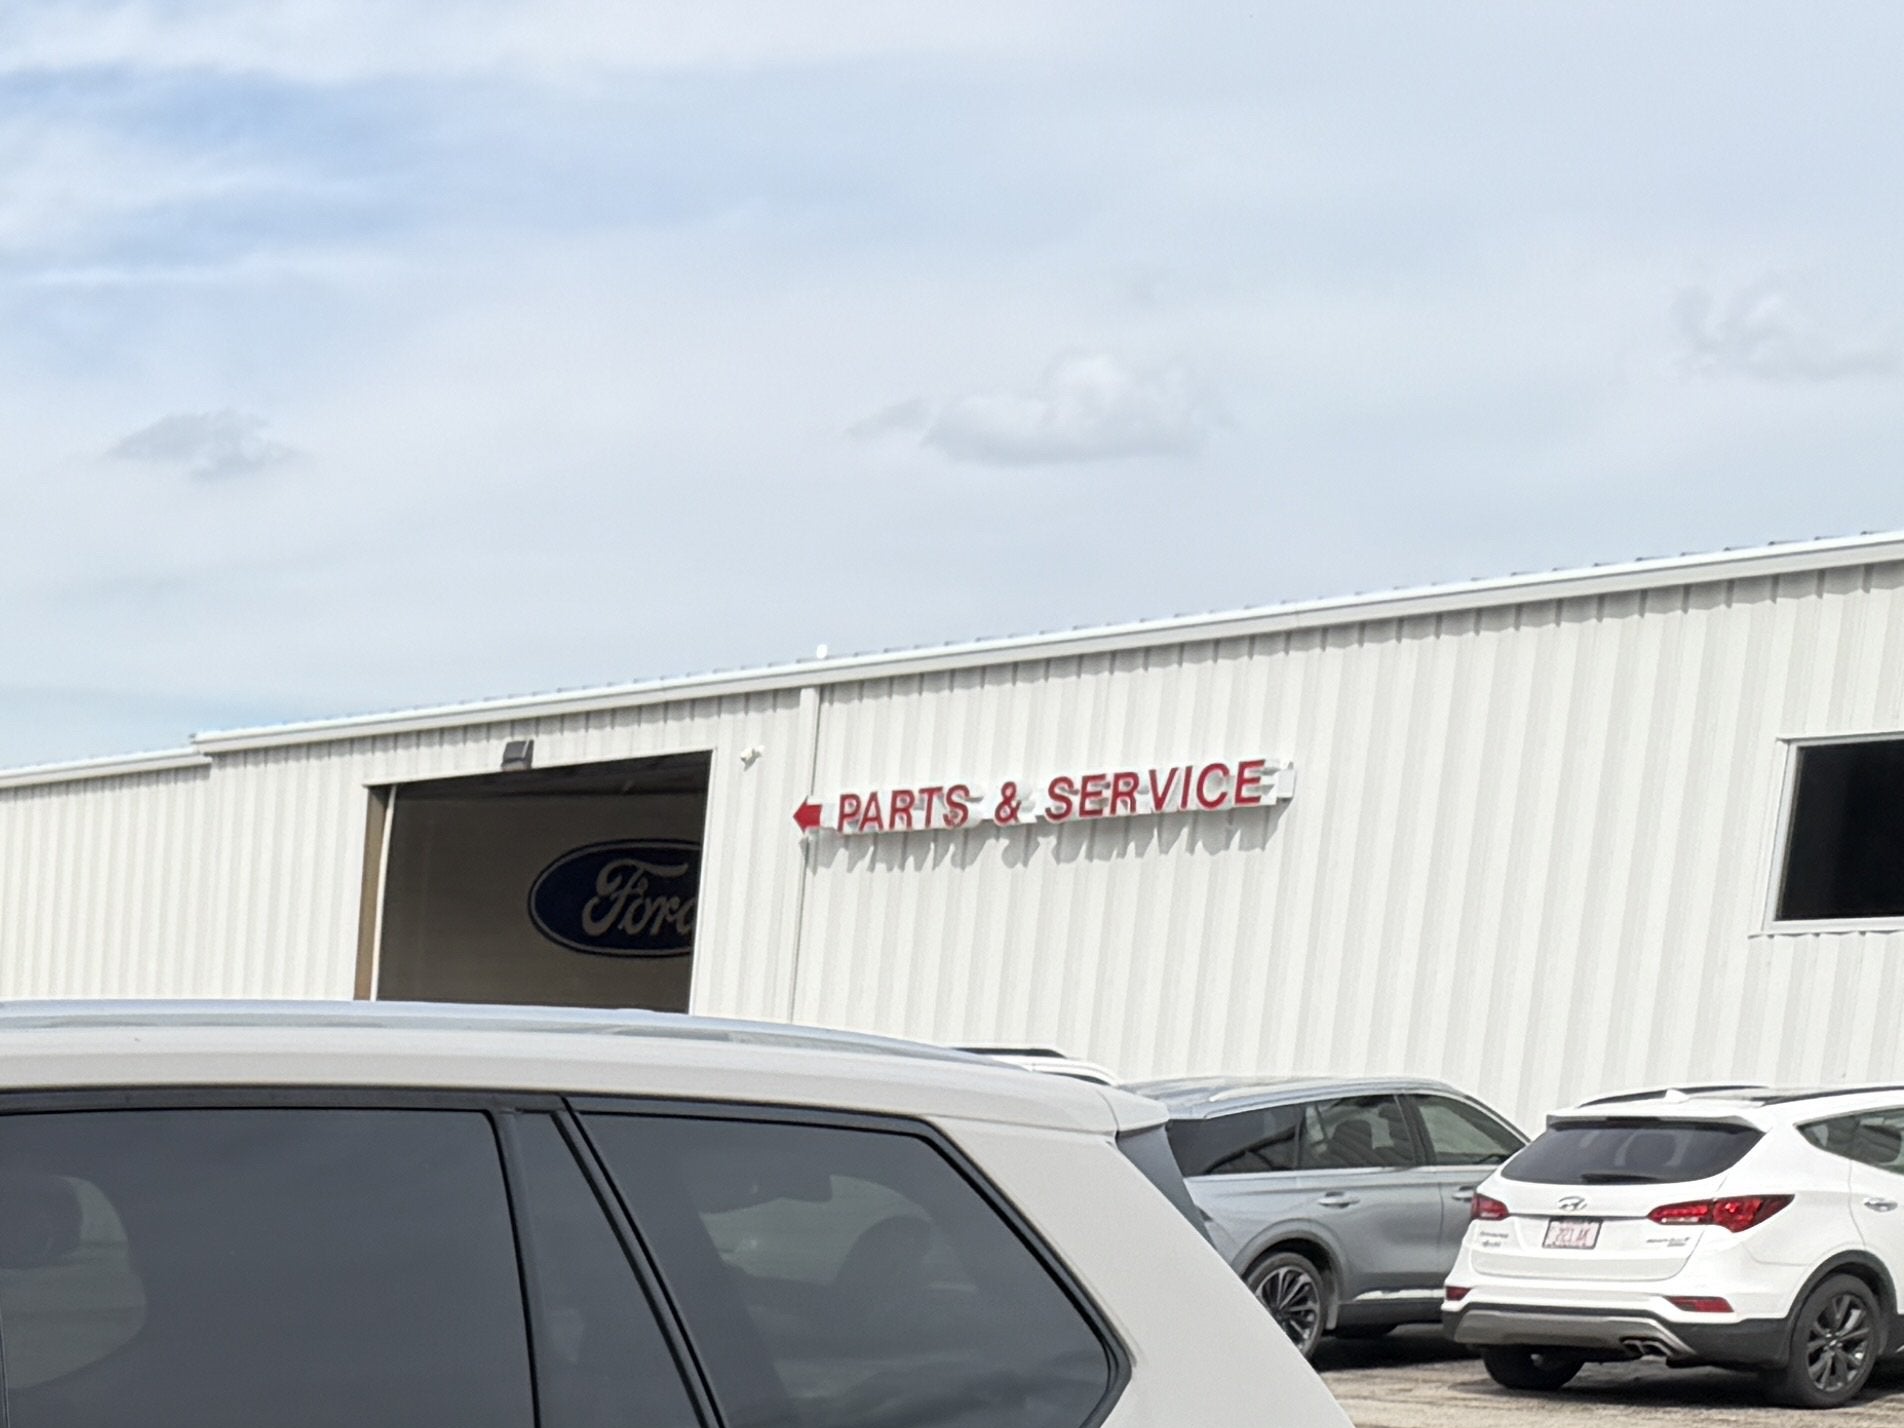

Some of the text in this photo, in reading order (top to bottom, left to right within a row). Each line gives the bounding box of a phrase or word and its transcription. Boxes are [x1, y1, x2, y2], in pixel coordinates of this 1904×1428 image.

[836, 759, 1267, 834] PARTS & SERVICE
